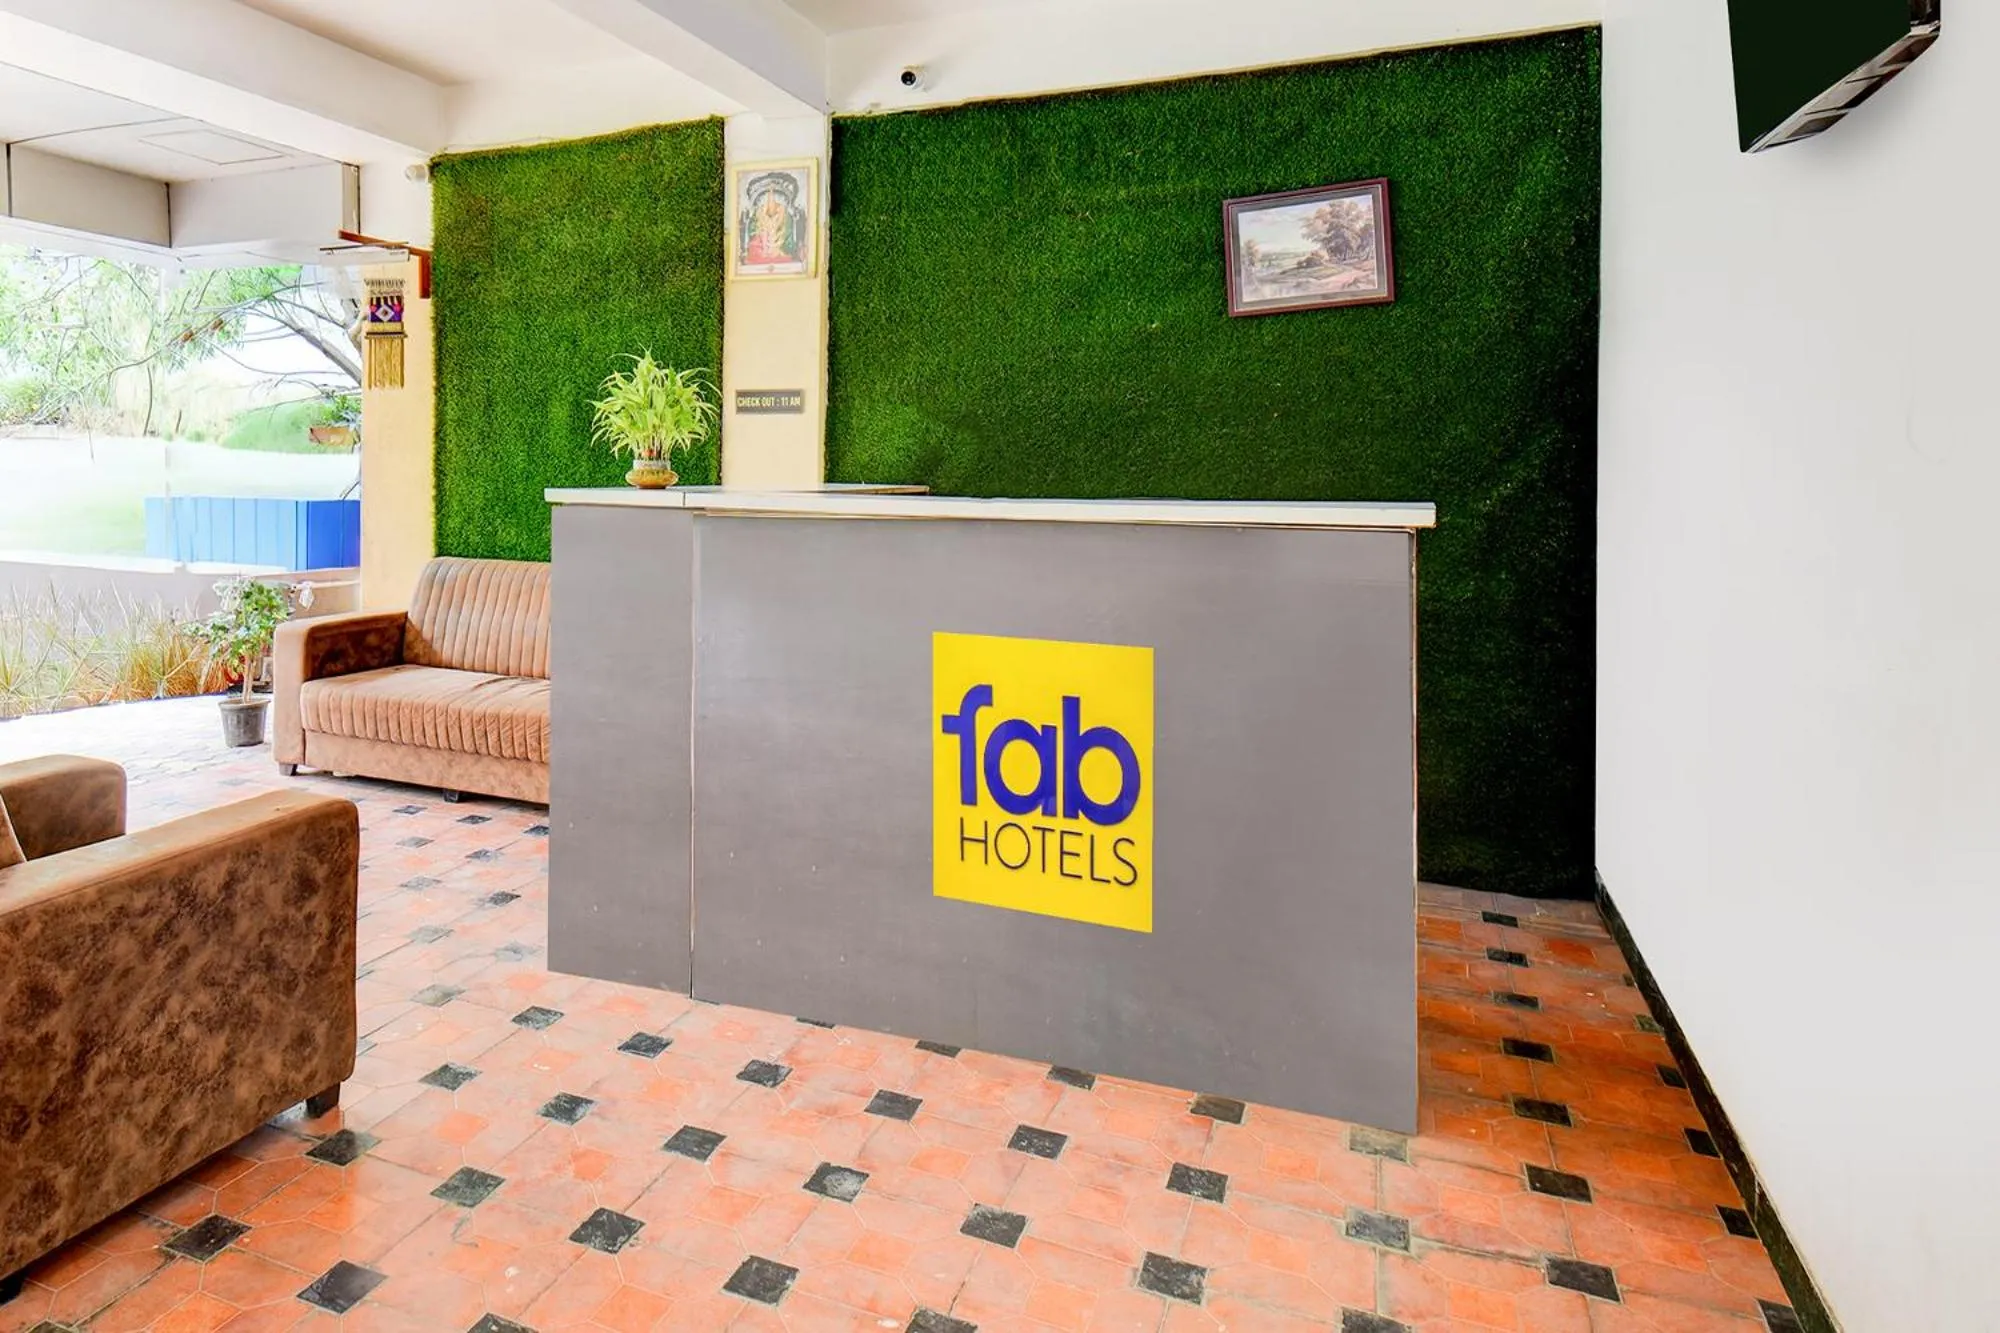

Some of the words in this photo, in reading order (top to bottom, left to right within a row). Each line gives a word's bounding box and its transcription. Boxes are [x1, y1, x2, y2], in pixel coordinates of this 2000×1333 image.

[736, 396, 761, 407] CHECK
[762, 396, 774, 407] OUT
[781, 396, 789, 406] 11
[790, 396, 801, 406] AM
[941, 683, 1141, 826] fab
[960, 816, 1138, 887] HOTELS
